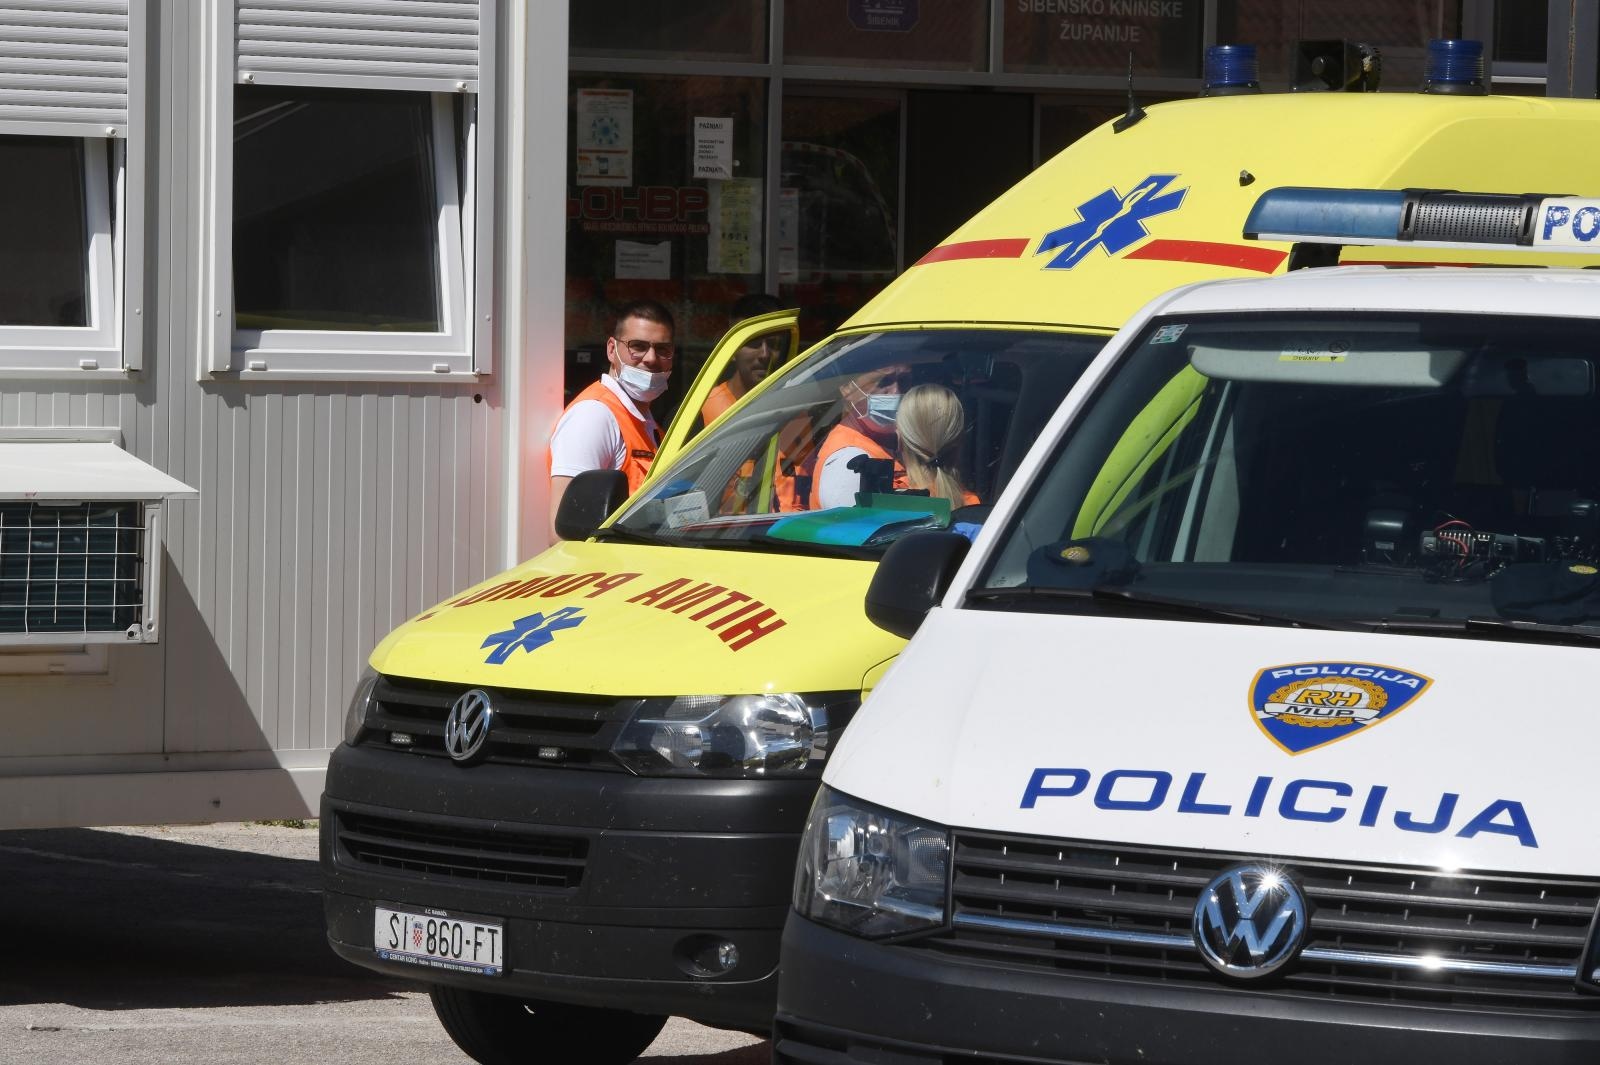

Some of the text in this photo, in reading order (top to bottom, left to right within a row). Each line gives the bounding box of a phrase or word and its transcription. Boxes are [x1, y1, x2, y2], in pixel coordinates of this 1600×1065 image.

[1109, 1, 1184, 18] KNINSKE
[1060, 19, 1141, 42] ŽUPANIJE
[1542, 206, 1600, 242] PO
[1271, 666, 1420, 689] POLICIJA
[1294, 689, 1362, 707] RH
[1285, 705, 1354, 718] MUP
[1019, 767, 1539, 849] POLICIJA
[426, 919, 499, 963] 860-FT
